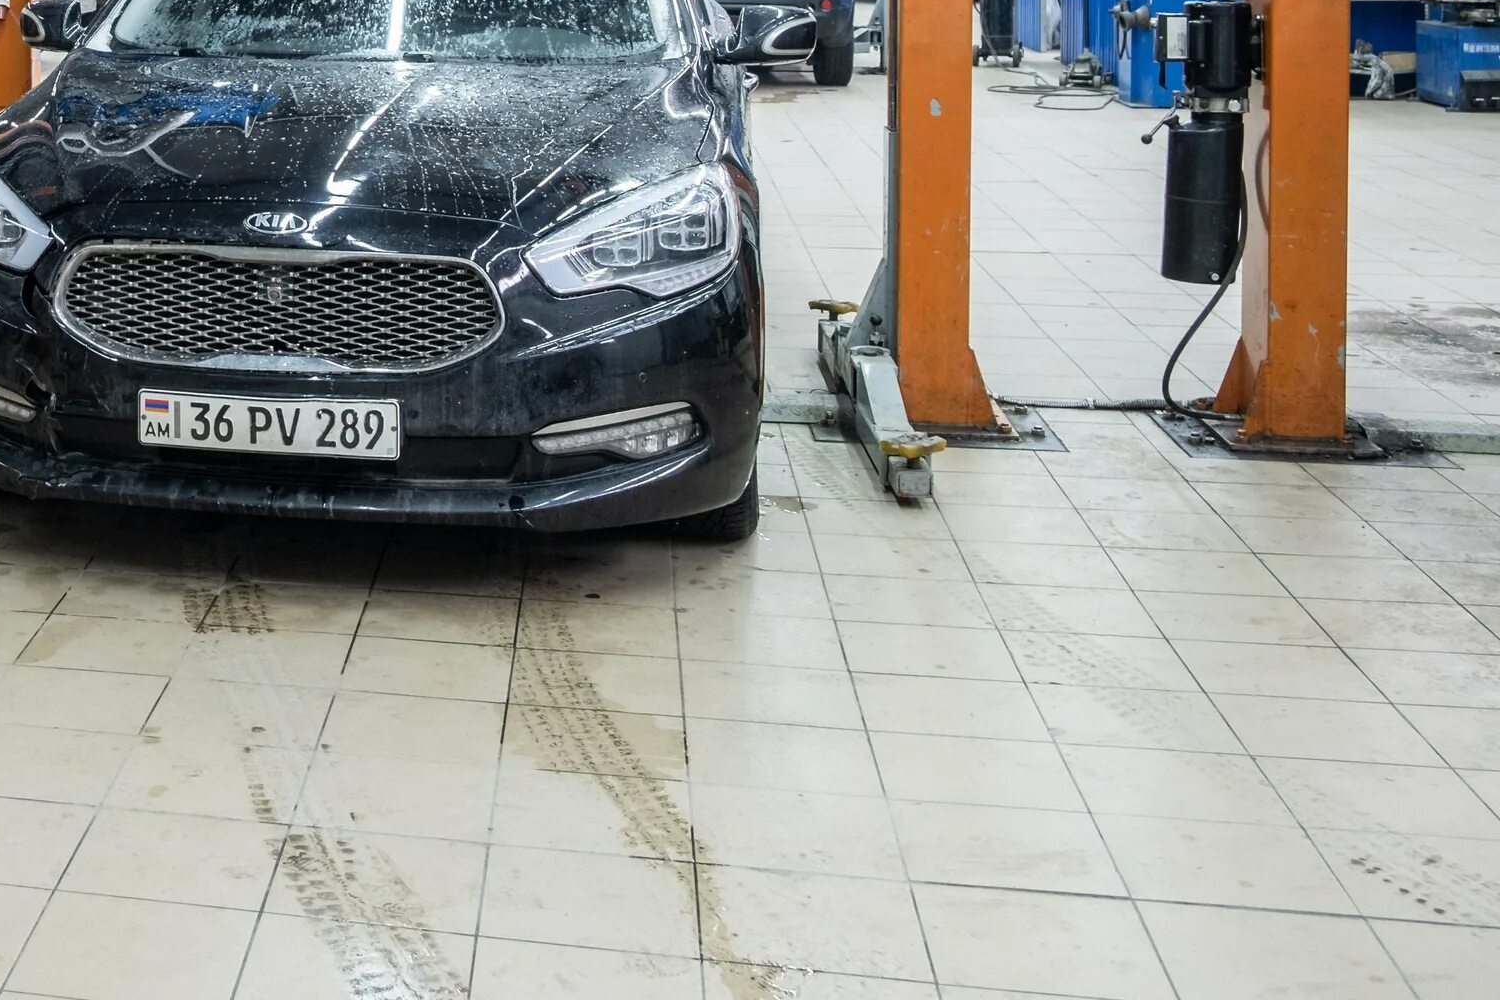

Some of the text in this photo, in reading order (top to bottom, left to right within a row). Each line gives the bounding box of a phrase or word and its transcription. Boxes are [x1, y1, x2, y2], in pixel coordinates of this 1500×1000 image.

[255, 213, 296, 230] KIA
[144, 402, 384, 450] AM 36 PV 289
